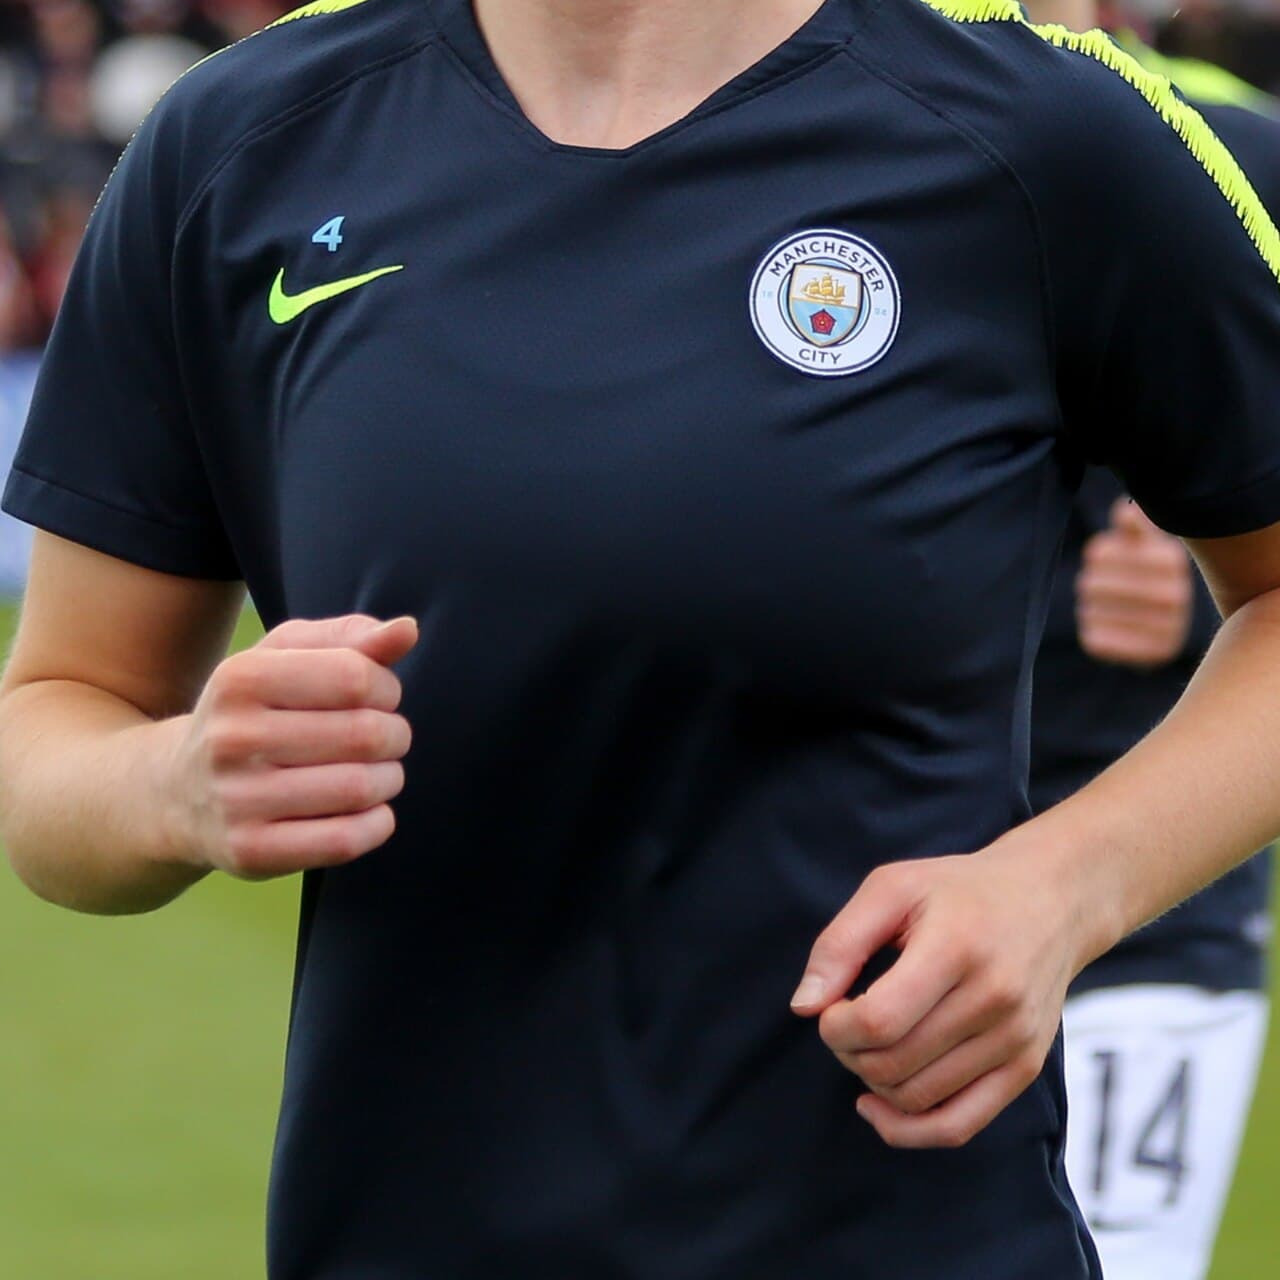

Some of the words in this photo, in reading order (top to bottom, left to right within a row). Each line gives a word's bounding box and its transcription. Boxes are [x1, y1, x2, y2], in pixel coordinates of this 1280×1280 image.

[312, 215, 345, 251] 4
[769, 241, 885, 292] MANCHESTER
[798, 348, 842, 364] CITY
[1089, 1049, 1193, 1208] 14
